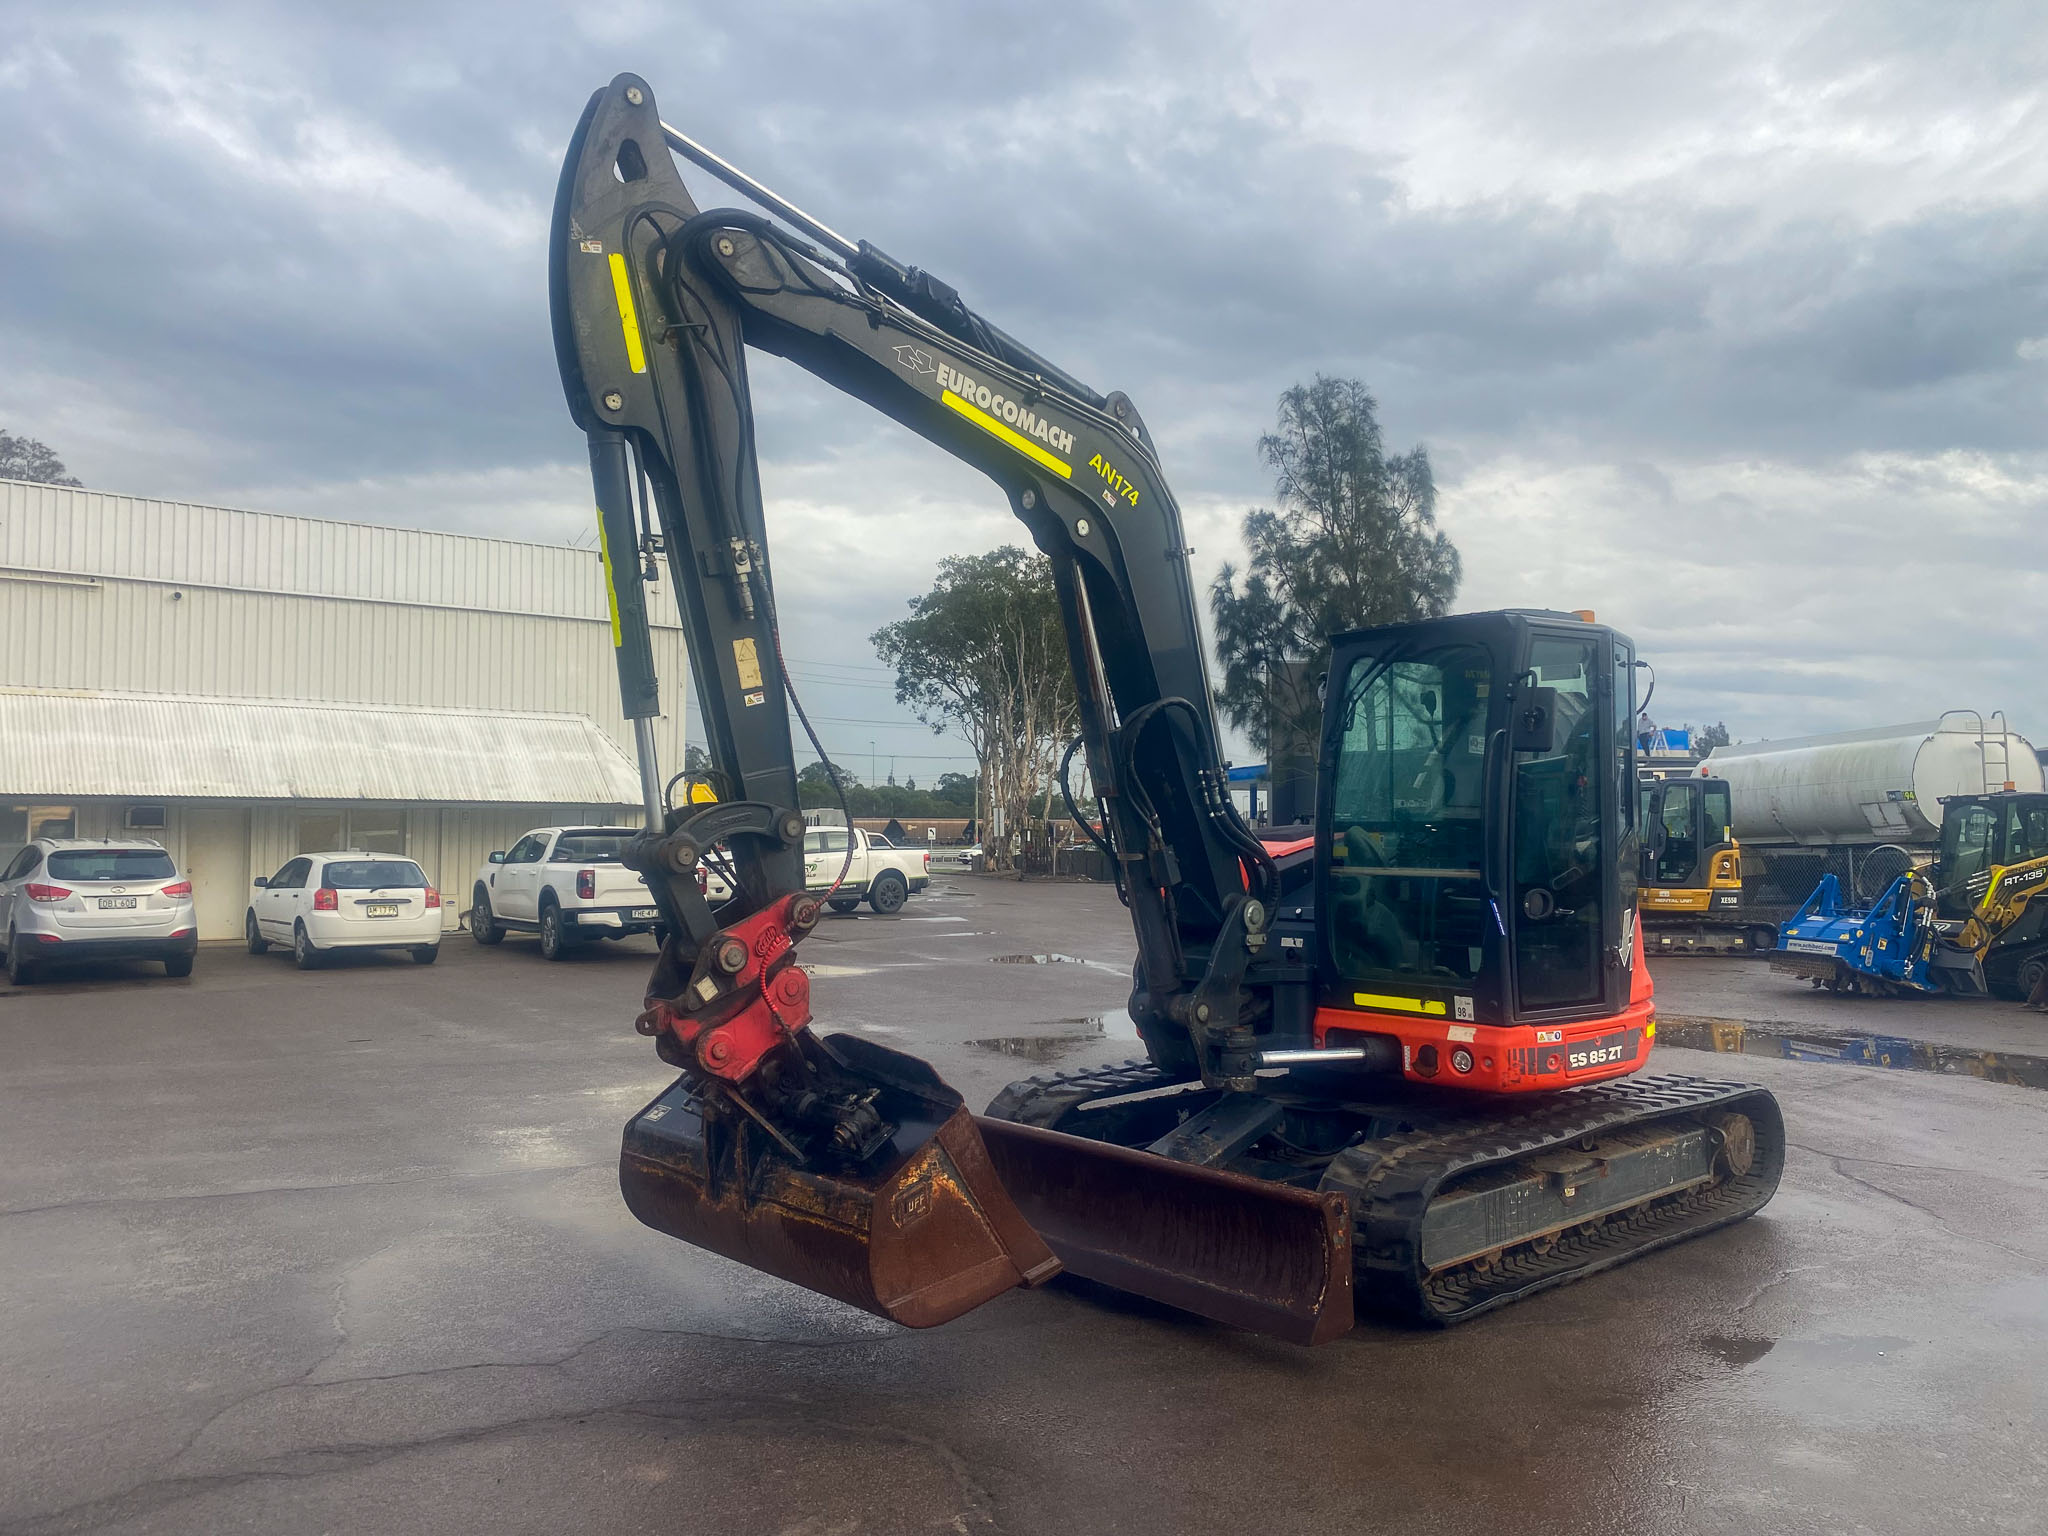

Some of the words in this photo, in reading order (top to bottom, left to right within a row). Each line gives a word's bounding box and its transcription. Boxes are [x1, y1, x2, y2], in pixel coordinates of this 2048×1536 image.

[936, 362, 1074, 454] EUROCOMACH
[1088, 453, 1140, 507] AN174
[2004, 869, 2043, 886] RT-135
[1457, 1006, 1467, 1018] 98
[1569, 1052, 1588, 1068] ES
[1589, 1049, 1607, 1064] 85
[1608, 1045, 1623, 1061] ZT
